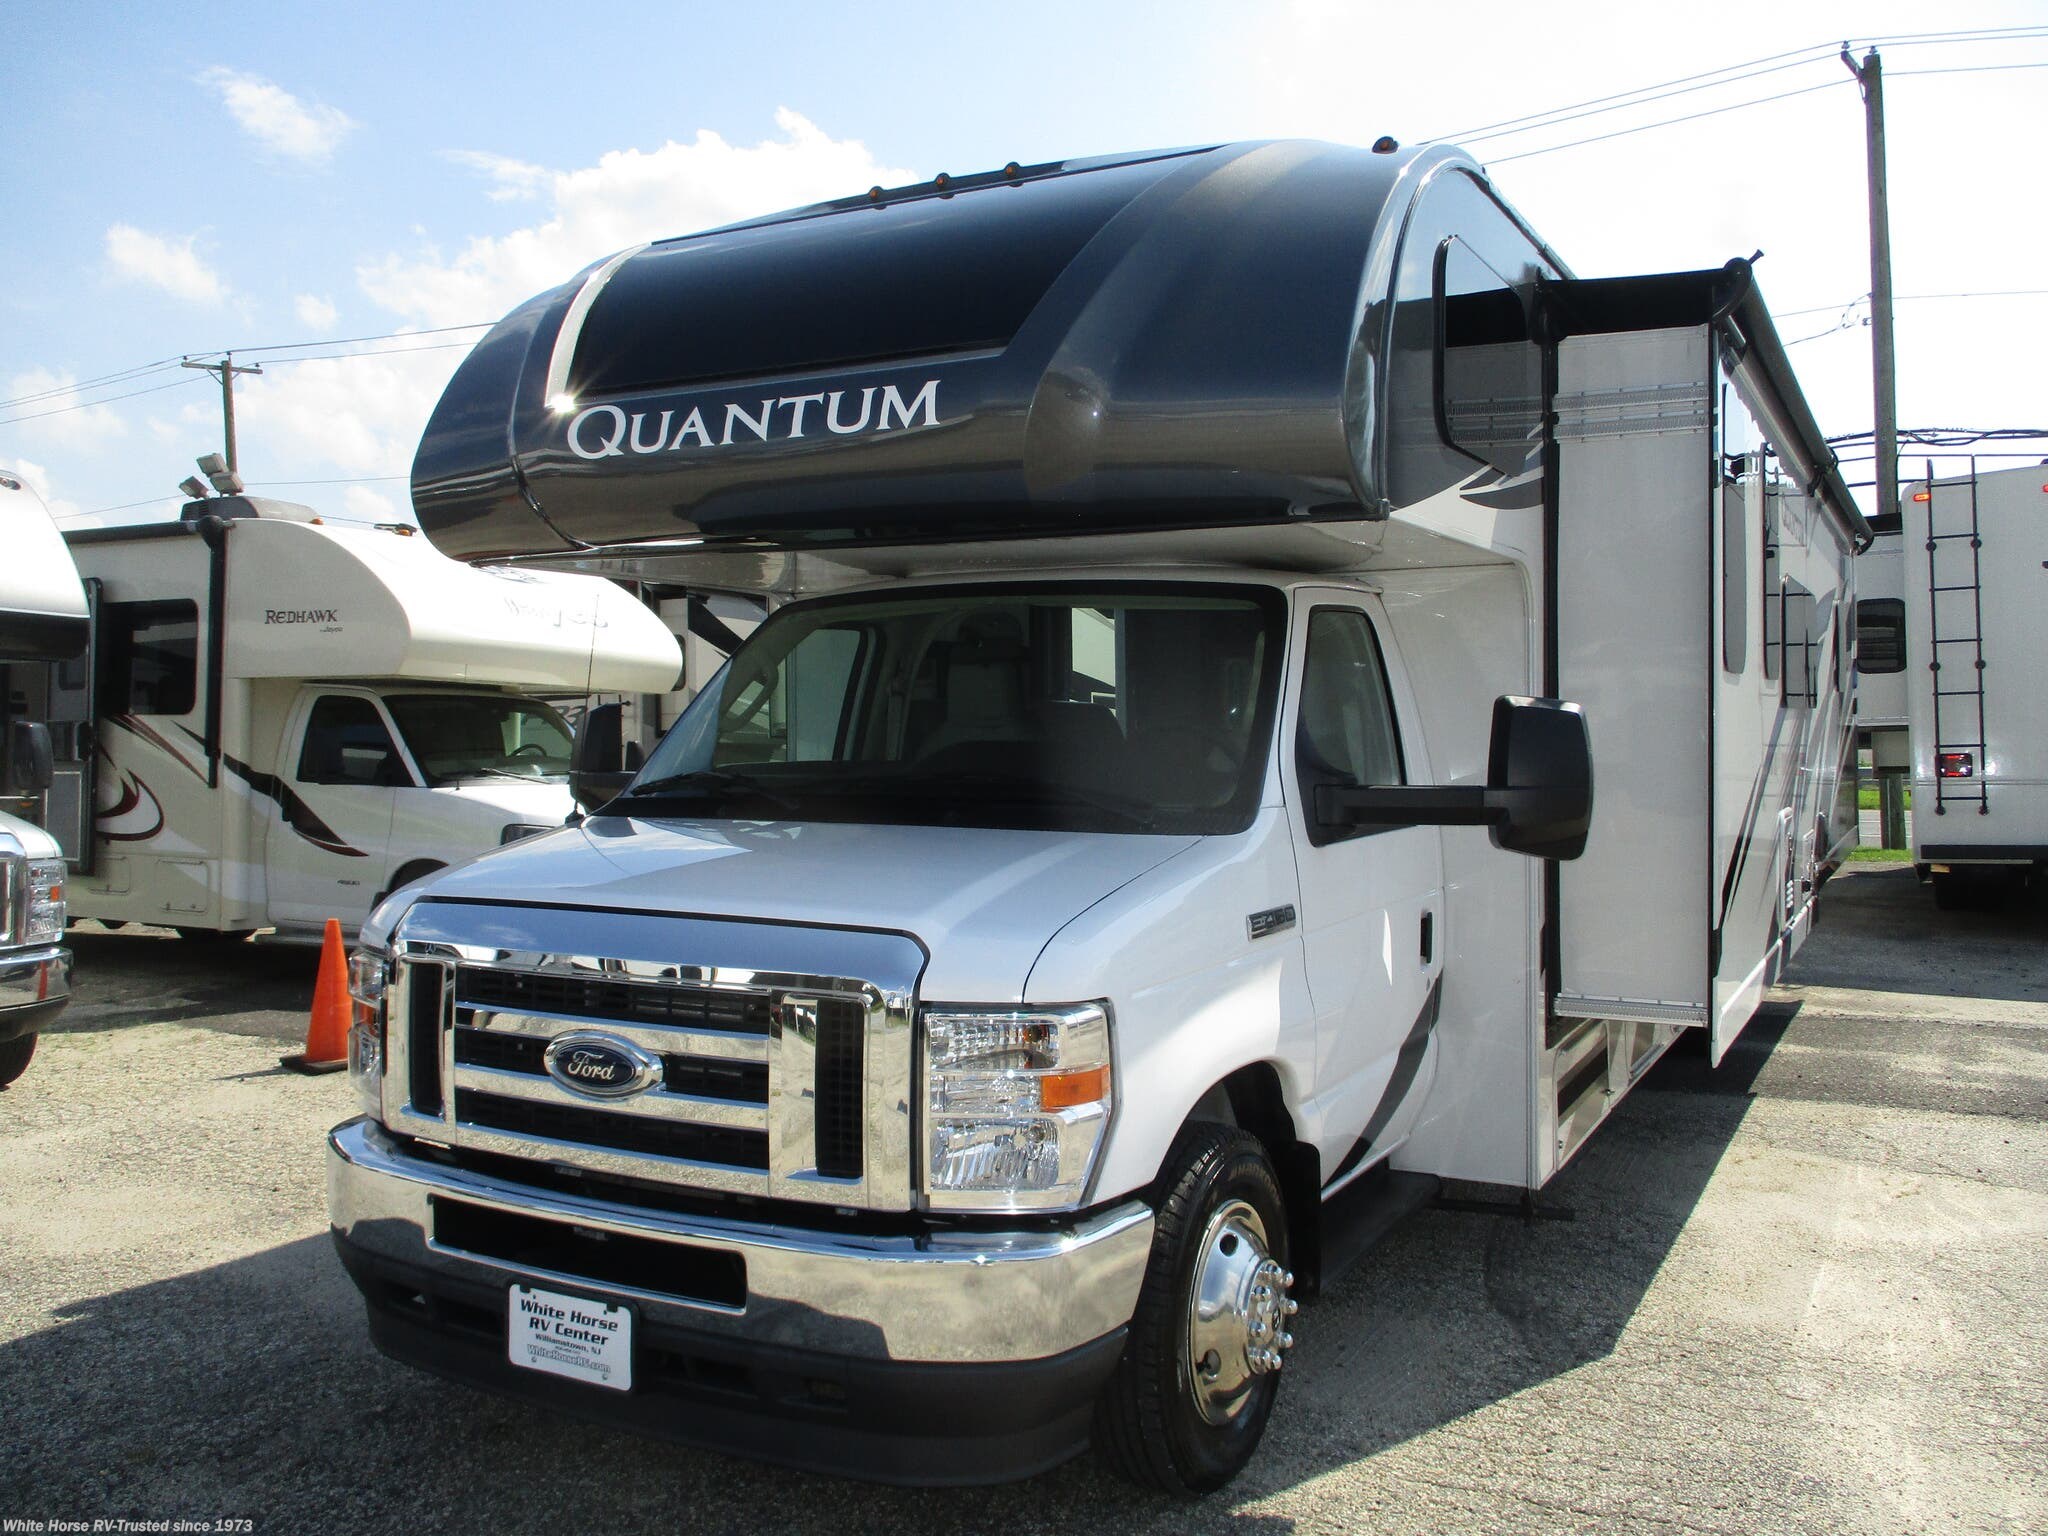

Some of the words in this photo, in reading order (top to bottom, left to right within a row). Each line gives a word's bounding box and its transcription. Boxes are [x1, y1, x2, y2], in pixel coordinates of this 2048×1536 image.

[567, 379, 942, 461] QUANTUM
[264, 608, 338, 624] REDHAWK
[568, 1051, 616, 1080] Ford
[520, 1298, 566, 1320] White
[570, 1310, 618, 1332] Horse
[529, 1316, 551, 1332] RV
[555, 1322, 609, 1346] Center
